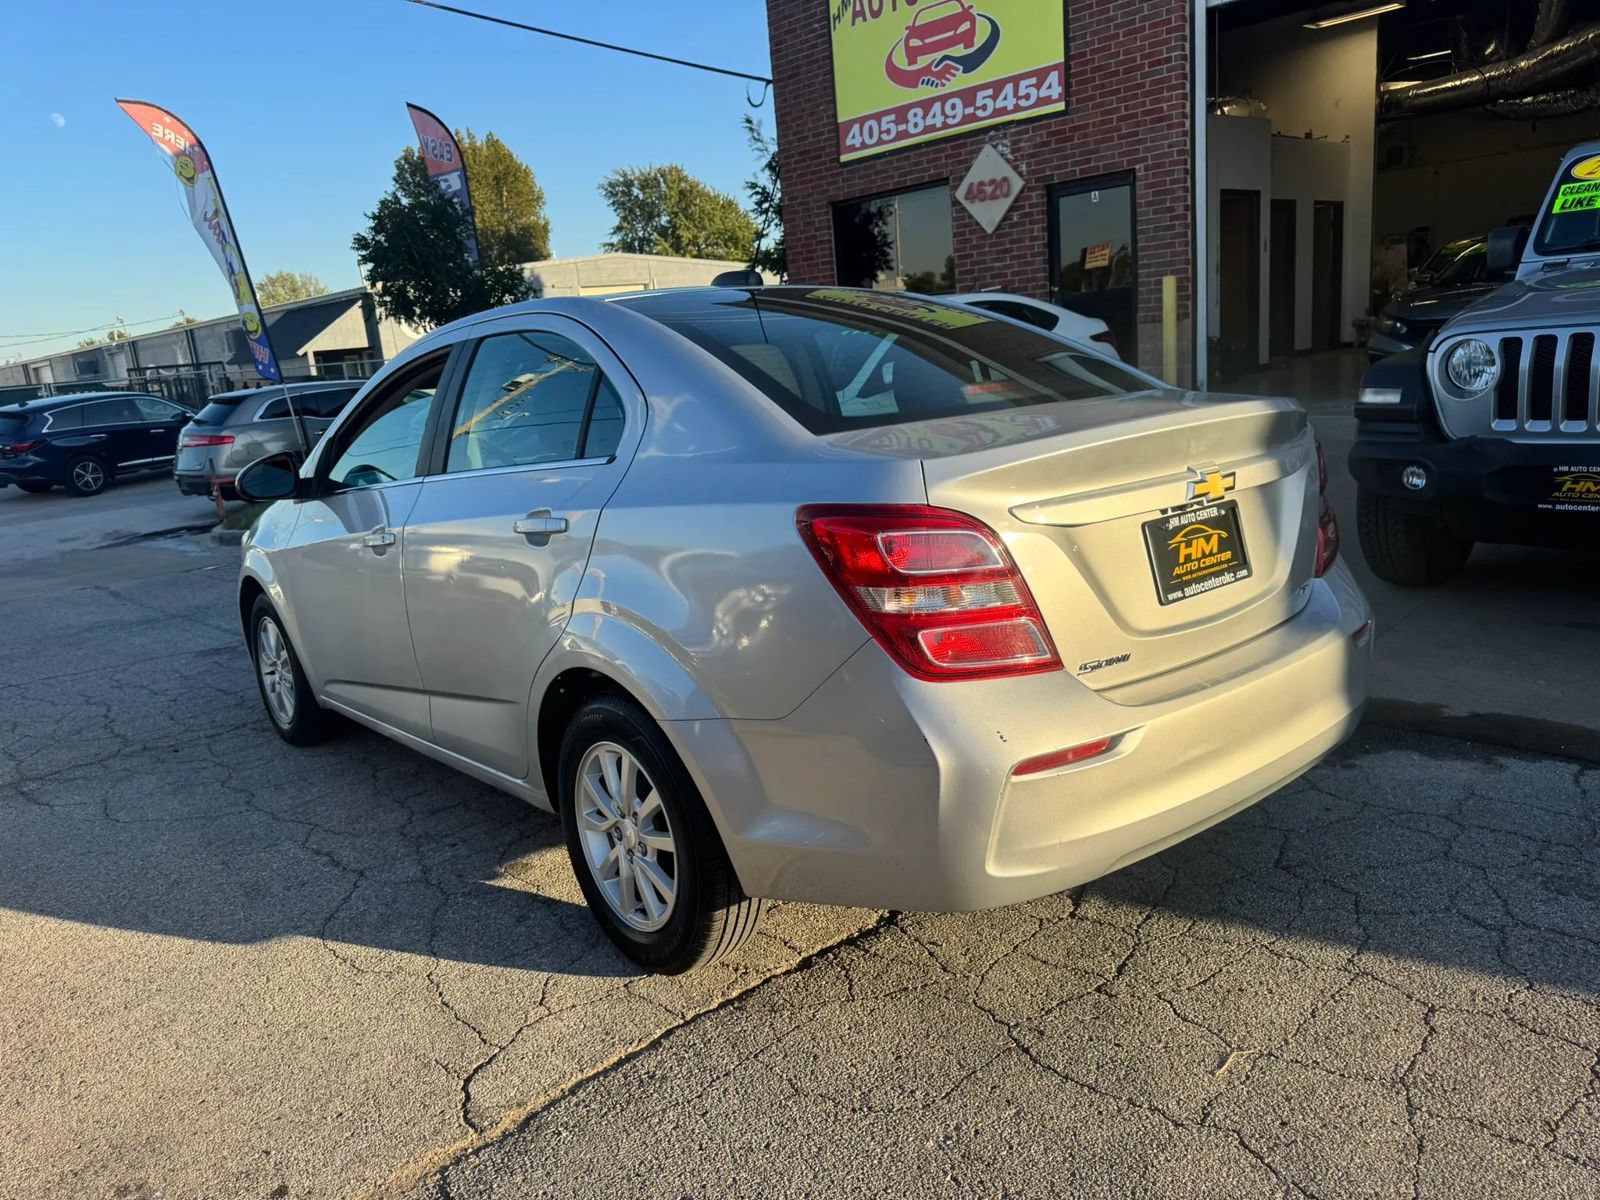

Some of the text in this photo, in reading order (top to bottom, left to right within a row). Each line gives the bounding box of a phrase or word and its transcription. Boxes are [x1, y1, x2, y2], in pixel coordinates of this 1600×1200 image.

[851, 0, 918, 27] AU
[845, 70, 1062, 149] 405-849-5454
[965, 176, 1010, 203] 4620
[1559, 195, 1598, 210] LIKE
[1180, 511, 1196, 525] AUTO
[1196, 507, 1219, 521] CENTER
[1179, 533, 1219, 564] HM
[1173, 551, 1232, 576] AUTO CENTER
